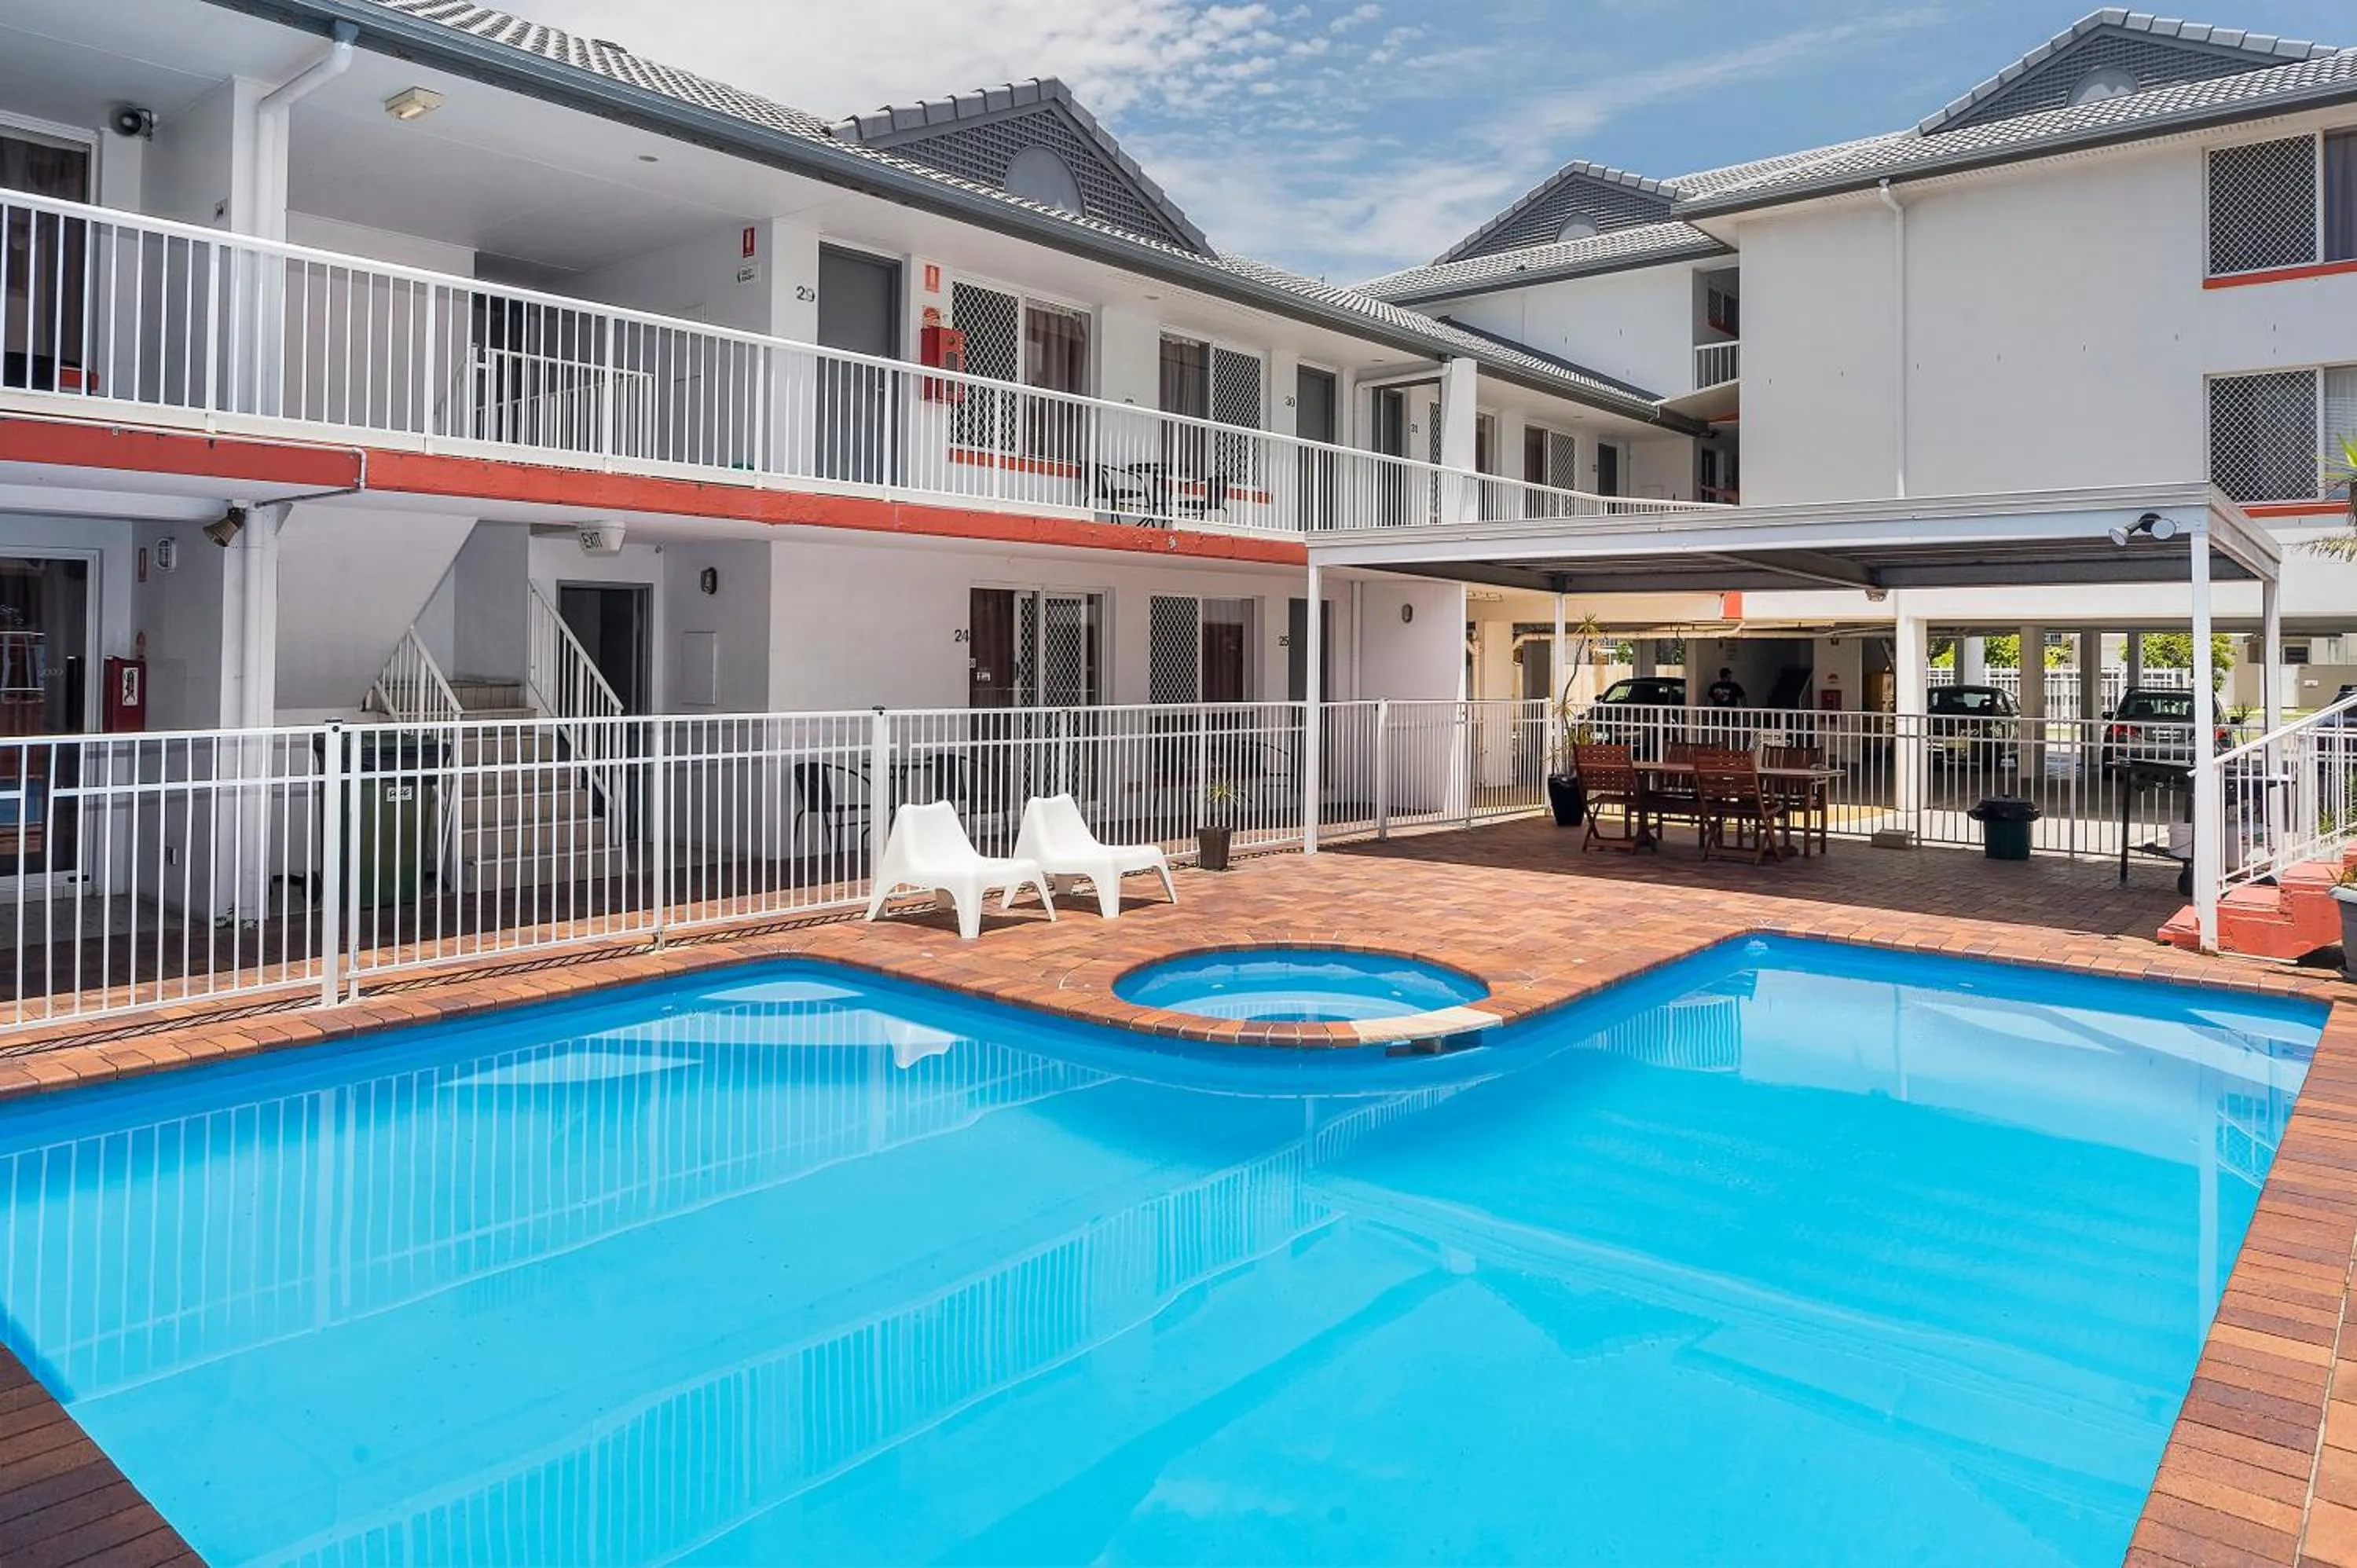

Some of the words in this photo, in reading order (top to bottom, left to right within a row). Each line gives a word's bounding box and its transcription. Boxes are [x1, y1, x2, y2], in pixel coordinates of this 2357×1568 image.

[796, 285, 815, 302] 29
[1285, 395, 1296, 408] 30
[581, 533, 603, 549] EXIT
[955, 629, 969, 643] 24
[1279, 636, 1289, 647] 25
